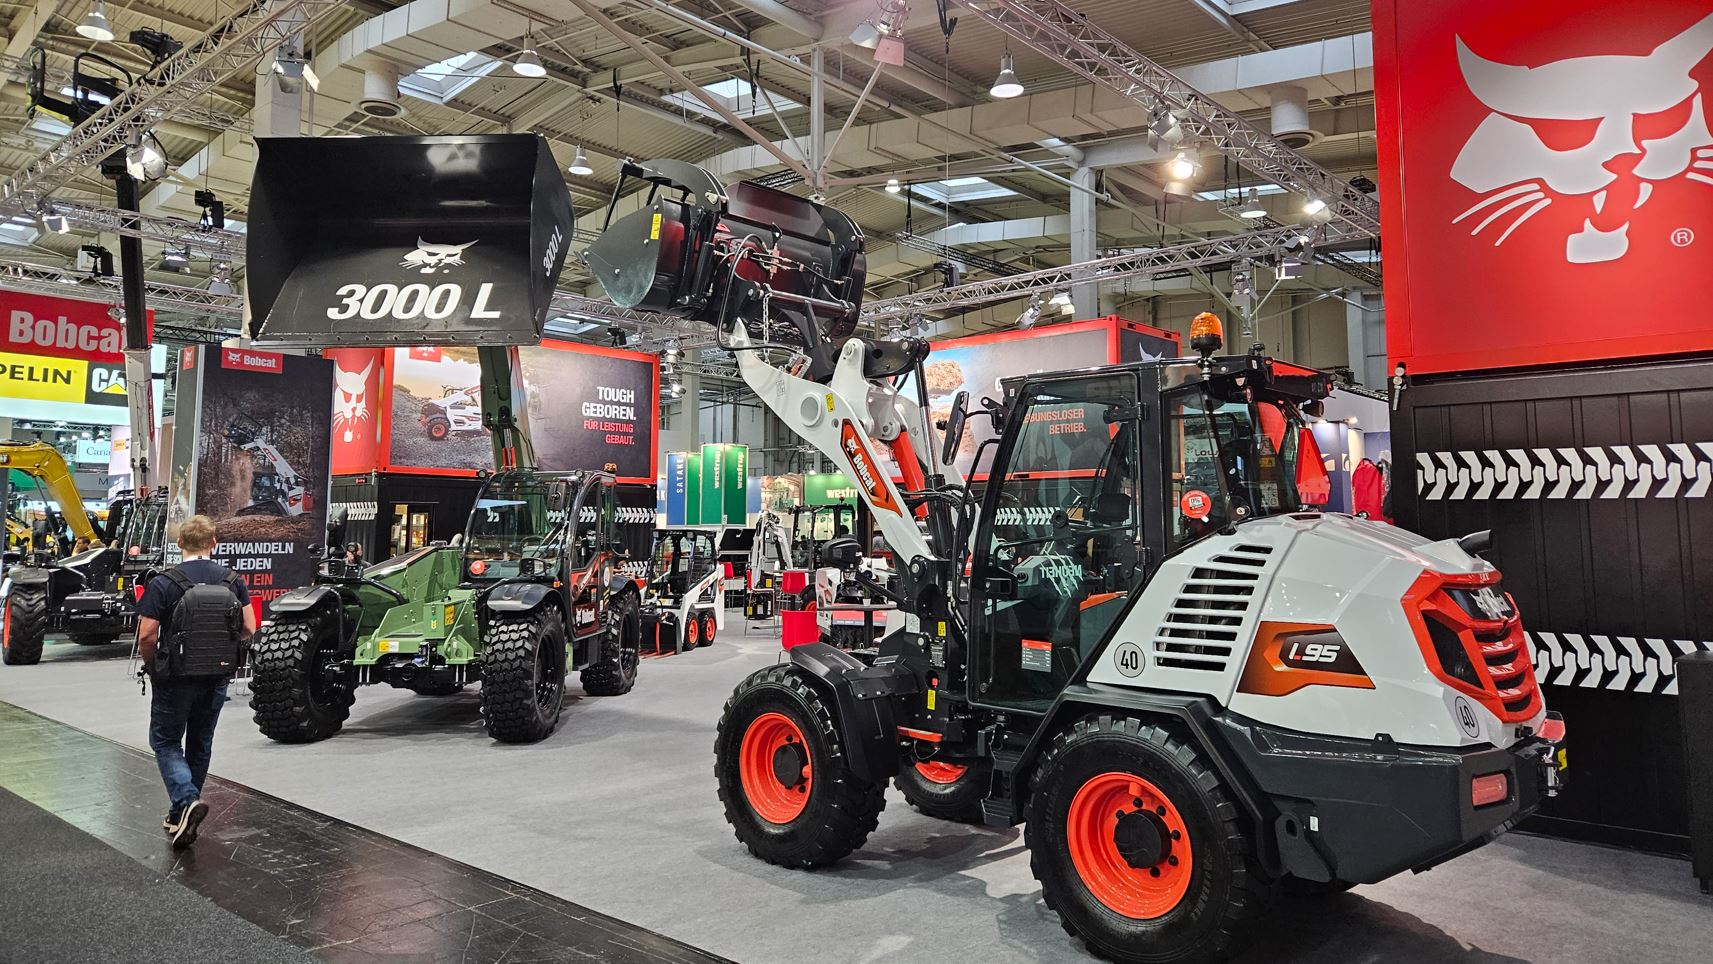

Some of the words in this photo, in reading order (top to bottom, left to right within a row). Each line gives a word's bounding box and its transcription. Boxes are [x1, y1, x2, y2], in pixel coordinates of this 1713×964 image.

[543, 240, 559, 277] 3000
[327, 282, 462, 320] 3000
[470, 282, 501, 319] L
[9, 310, 127, 353] Bobca
[243, 355, 277, 368] Bobcat
[596, 386, 635, 403] TOUGH
[581, 402, 637, 420] GEBOREN.
[583, 418, 599, 430] FÜR
[599, 421, 634, 433] LEISTUNG
[1049, 422, 1087, 435] BETRIEB.
[605, 434, 635, 445] GEBAUT.
[86, 446, 110, 457] Cana
[676, 457, 684, 494] SATAKE
[853, 453, 877, 492] Bobcat
[211, 542, 294, 555] VERWANDELN
[232, 558, 272, 571] JEDEN
[253, 573, 273, 586] EIN
[1120, 650, 1139, 671] 40
[1289, 643, 1341, 663] L95
[1460, 705, 1475, 729] 40
